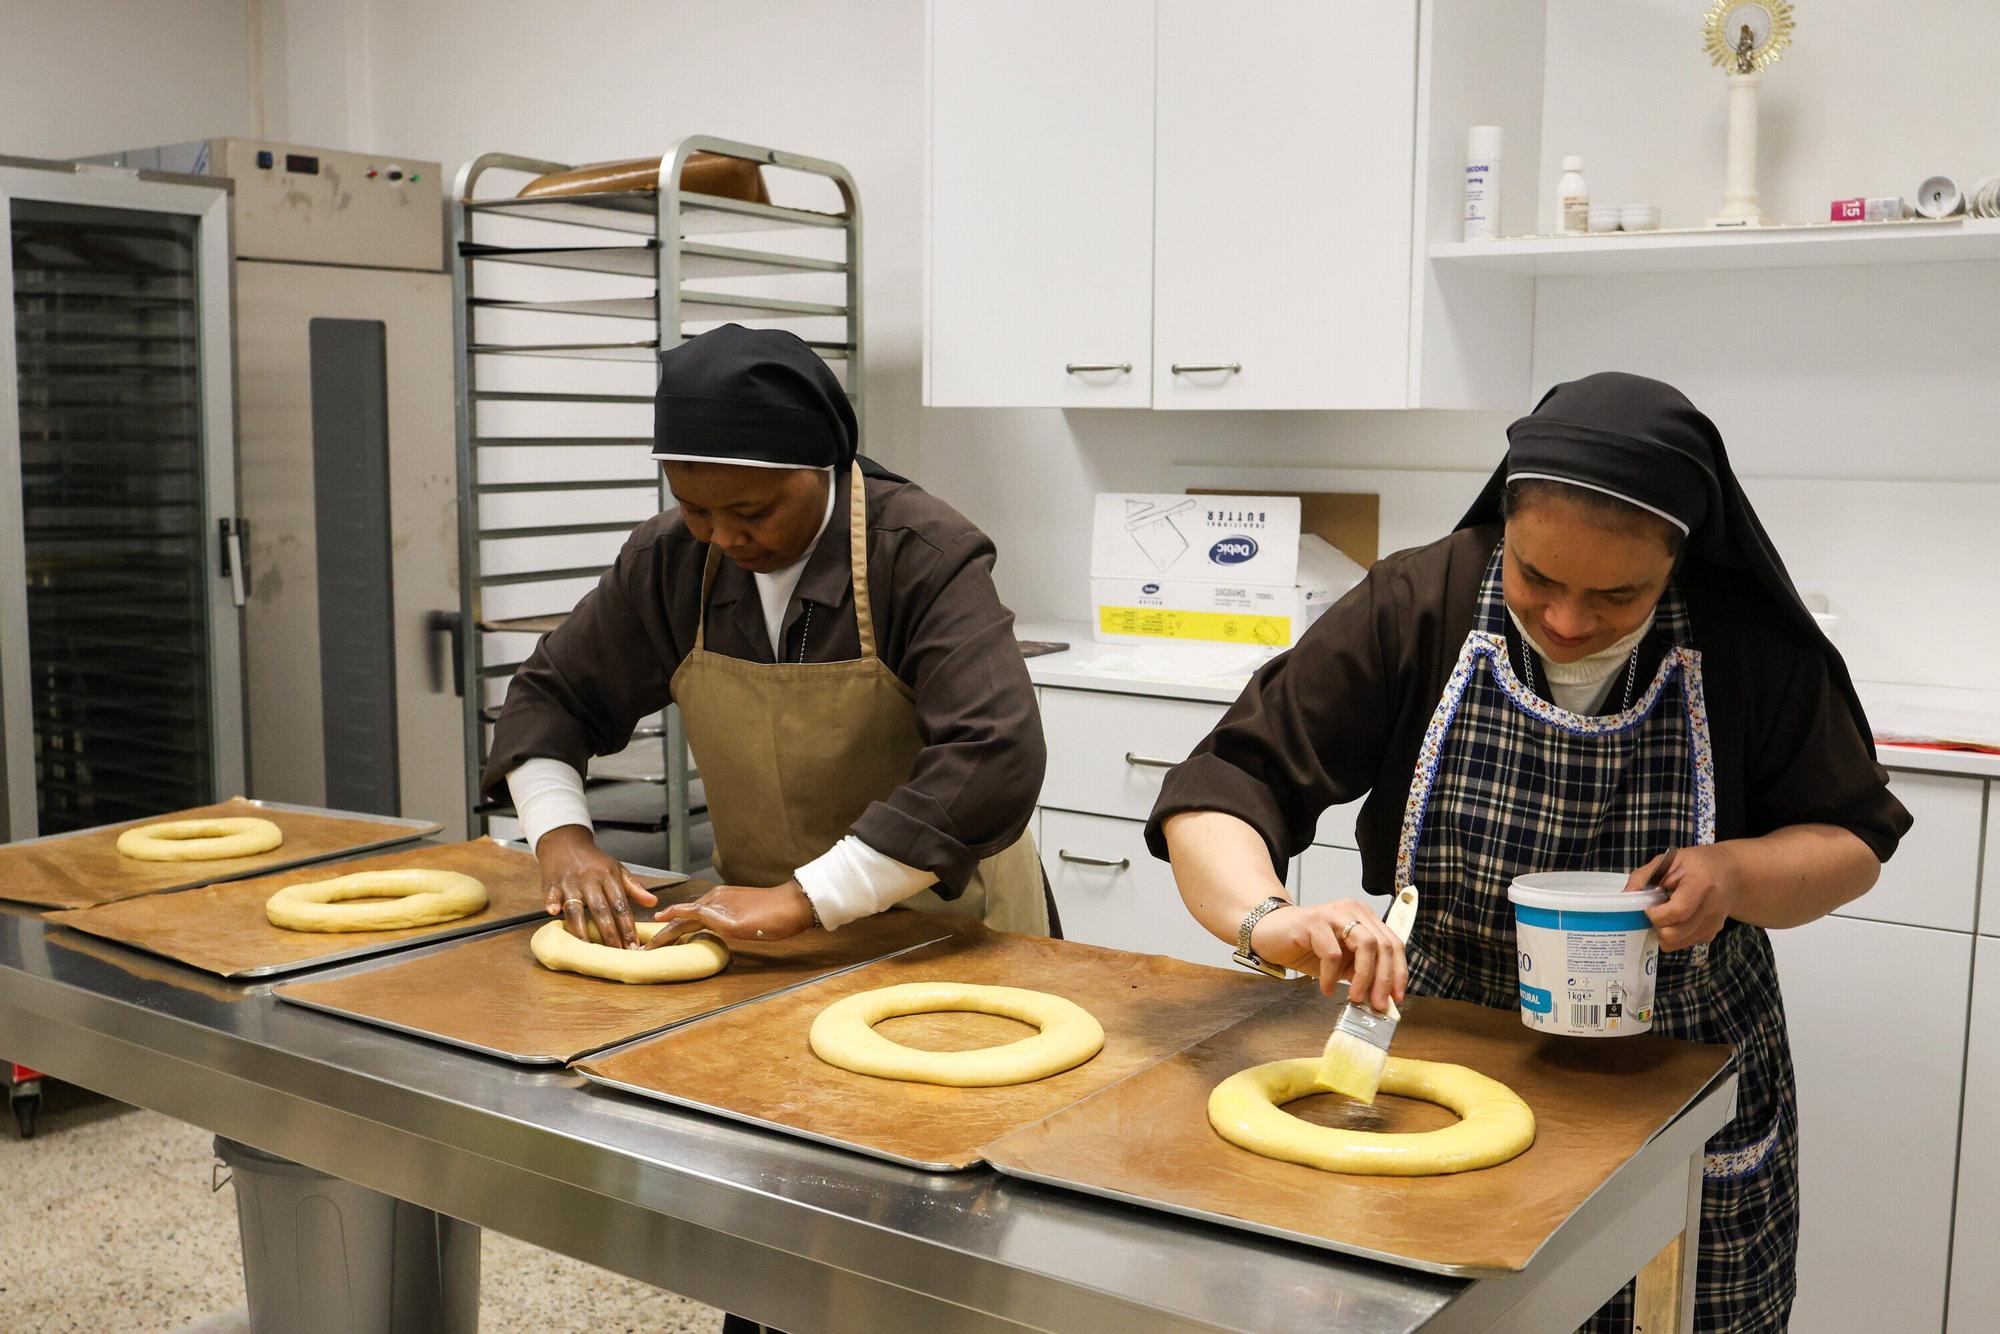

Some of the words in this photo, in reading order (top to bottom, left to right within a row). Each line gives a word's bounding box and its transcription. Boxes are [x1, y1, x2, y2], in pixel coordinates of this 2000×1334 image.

[1846, 201, 1860, 217] 15
[1207, 511, 1265, 522] BUTTER
[1217, 543, 1249, 557] Debic
